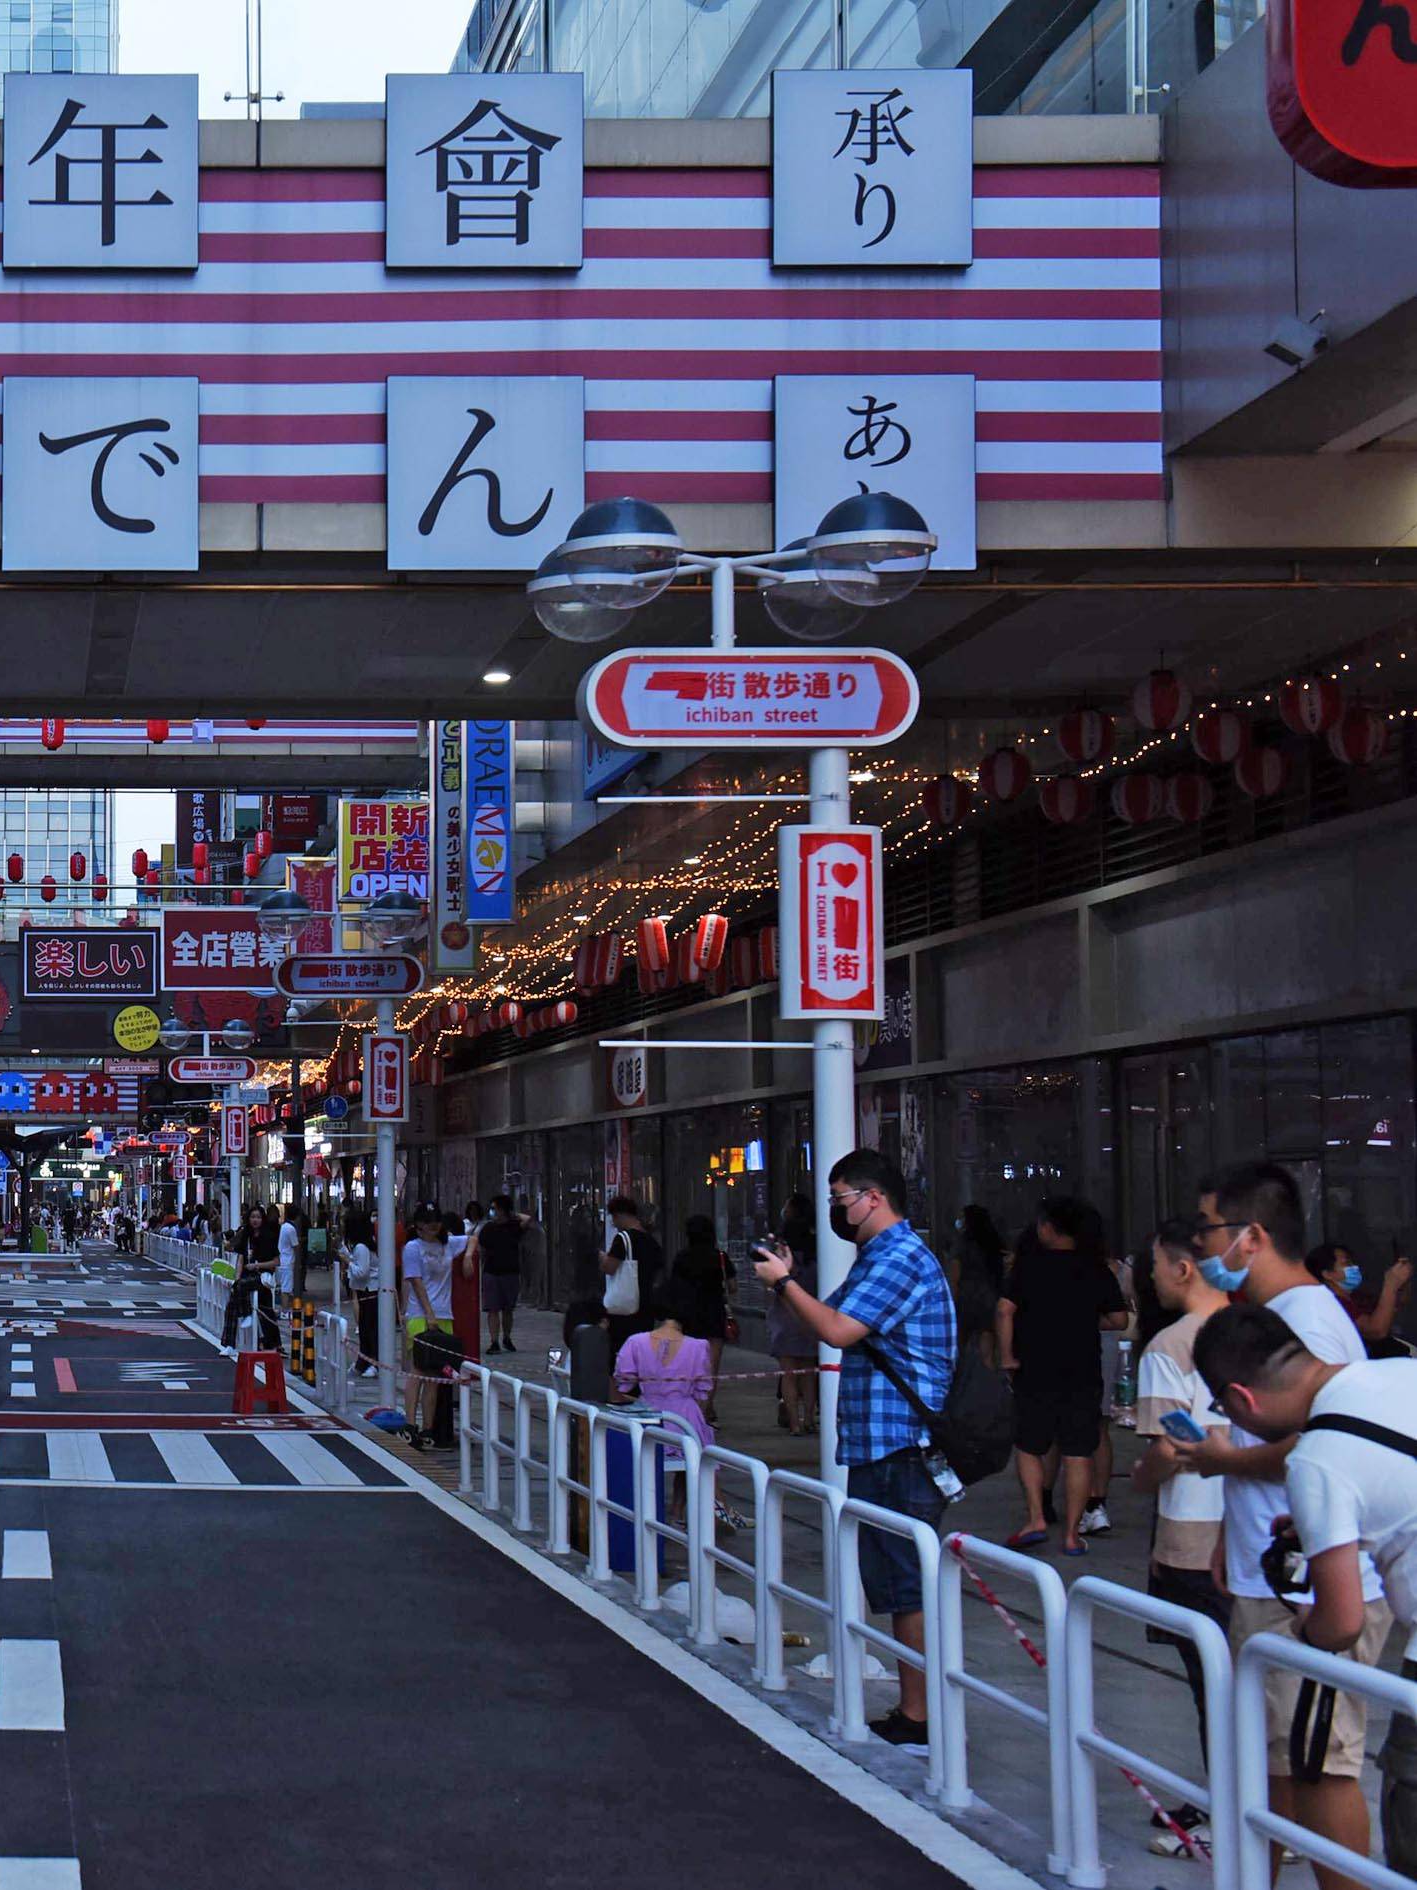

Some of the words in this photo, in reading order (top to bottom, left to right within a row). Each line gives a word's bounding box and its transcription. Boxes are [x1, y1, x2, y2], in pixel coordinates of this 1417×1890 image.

[832, 88, 917, 249] 承り
[843, 394, 912, 496] あ
[743, 672, 859, 700] 散歩通り
[685, 706, 754, 723] ichiban
[764, 707, 819, 723] street
[350, 874, 428, 898] OPEN
[817, 861, 828, 887] I
[816, 894, 828, 939] ICHIBAN
[35, 939, 146, 978] 楽しい
[816, 944, 828, 982] STREET
[833, 953, 861, 982] 街
[319, 979, 351, 988] ichiban
[355, 979, 380, 988] street
